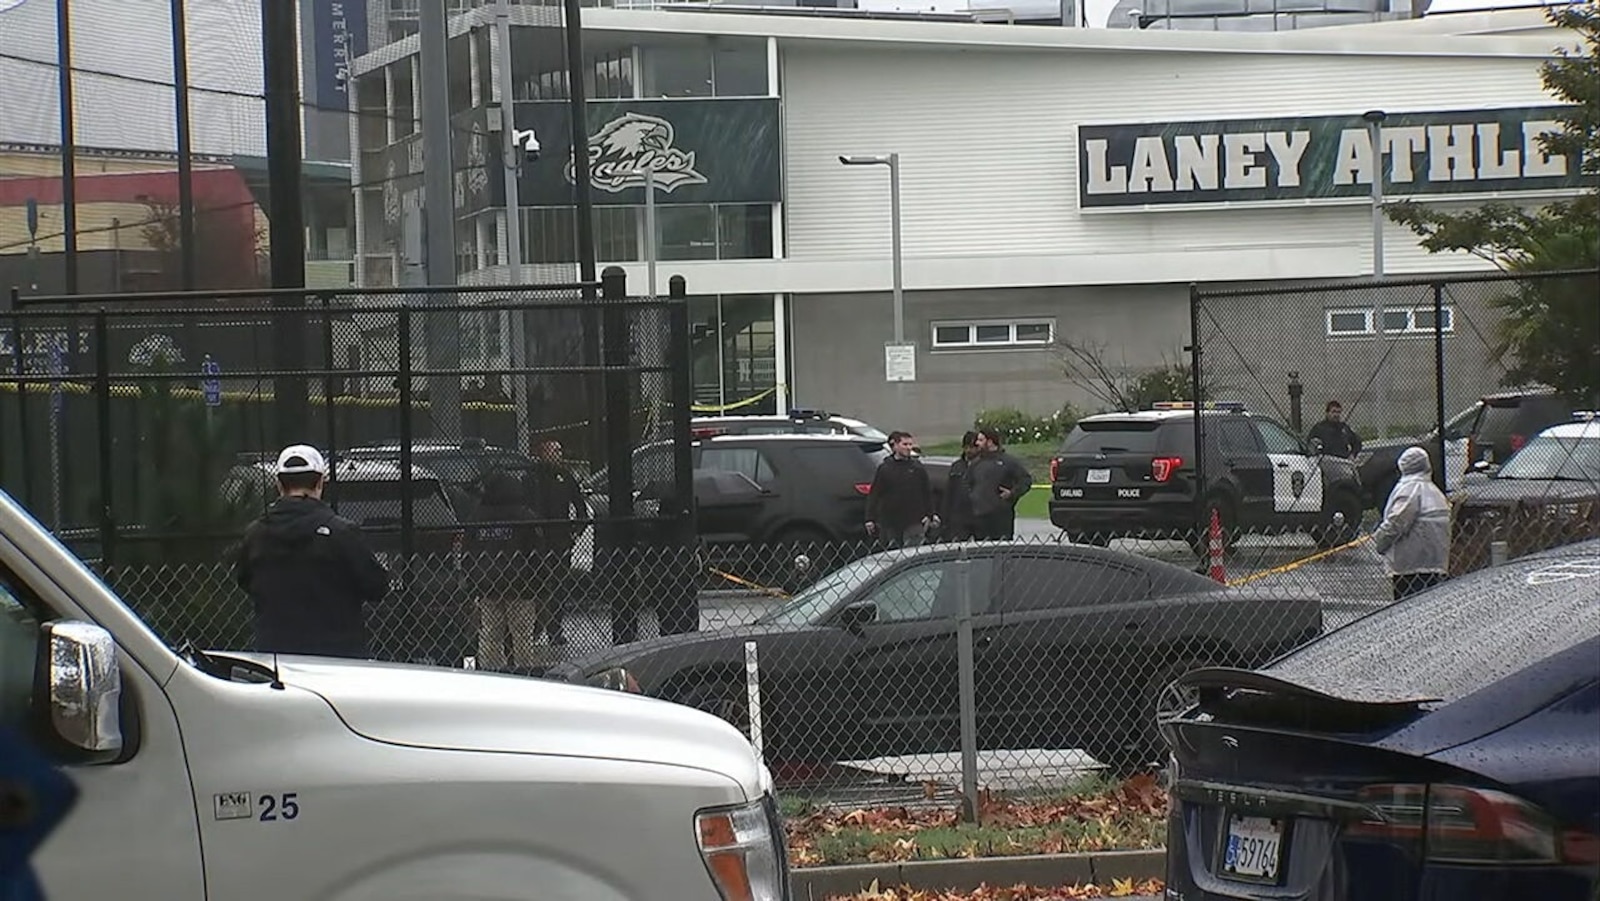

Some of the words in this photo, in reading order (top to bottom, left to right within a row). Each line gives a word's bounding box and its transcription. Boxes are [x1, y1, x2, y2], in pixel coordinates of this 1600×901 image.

[1085, 130, 1310, 195] LANEY
[1333, 120, 1600, 184] ATHLE
[1060, 488, 1083, 497] OAKLAND
[1117, 488, 1141, 497] POLICE
[258, 792, 299, 822] 25
[1207, 790, 1266, 807] TESLA
